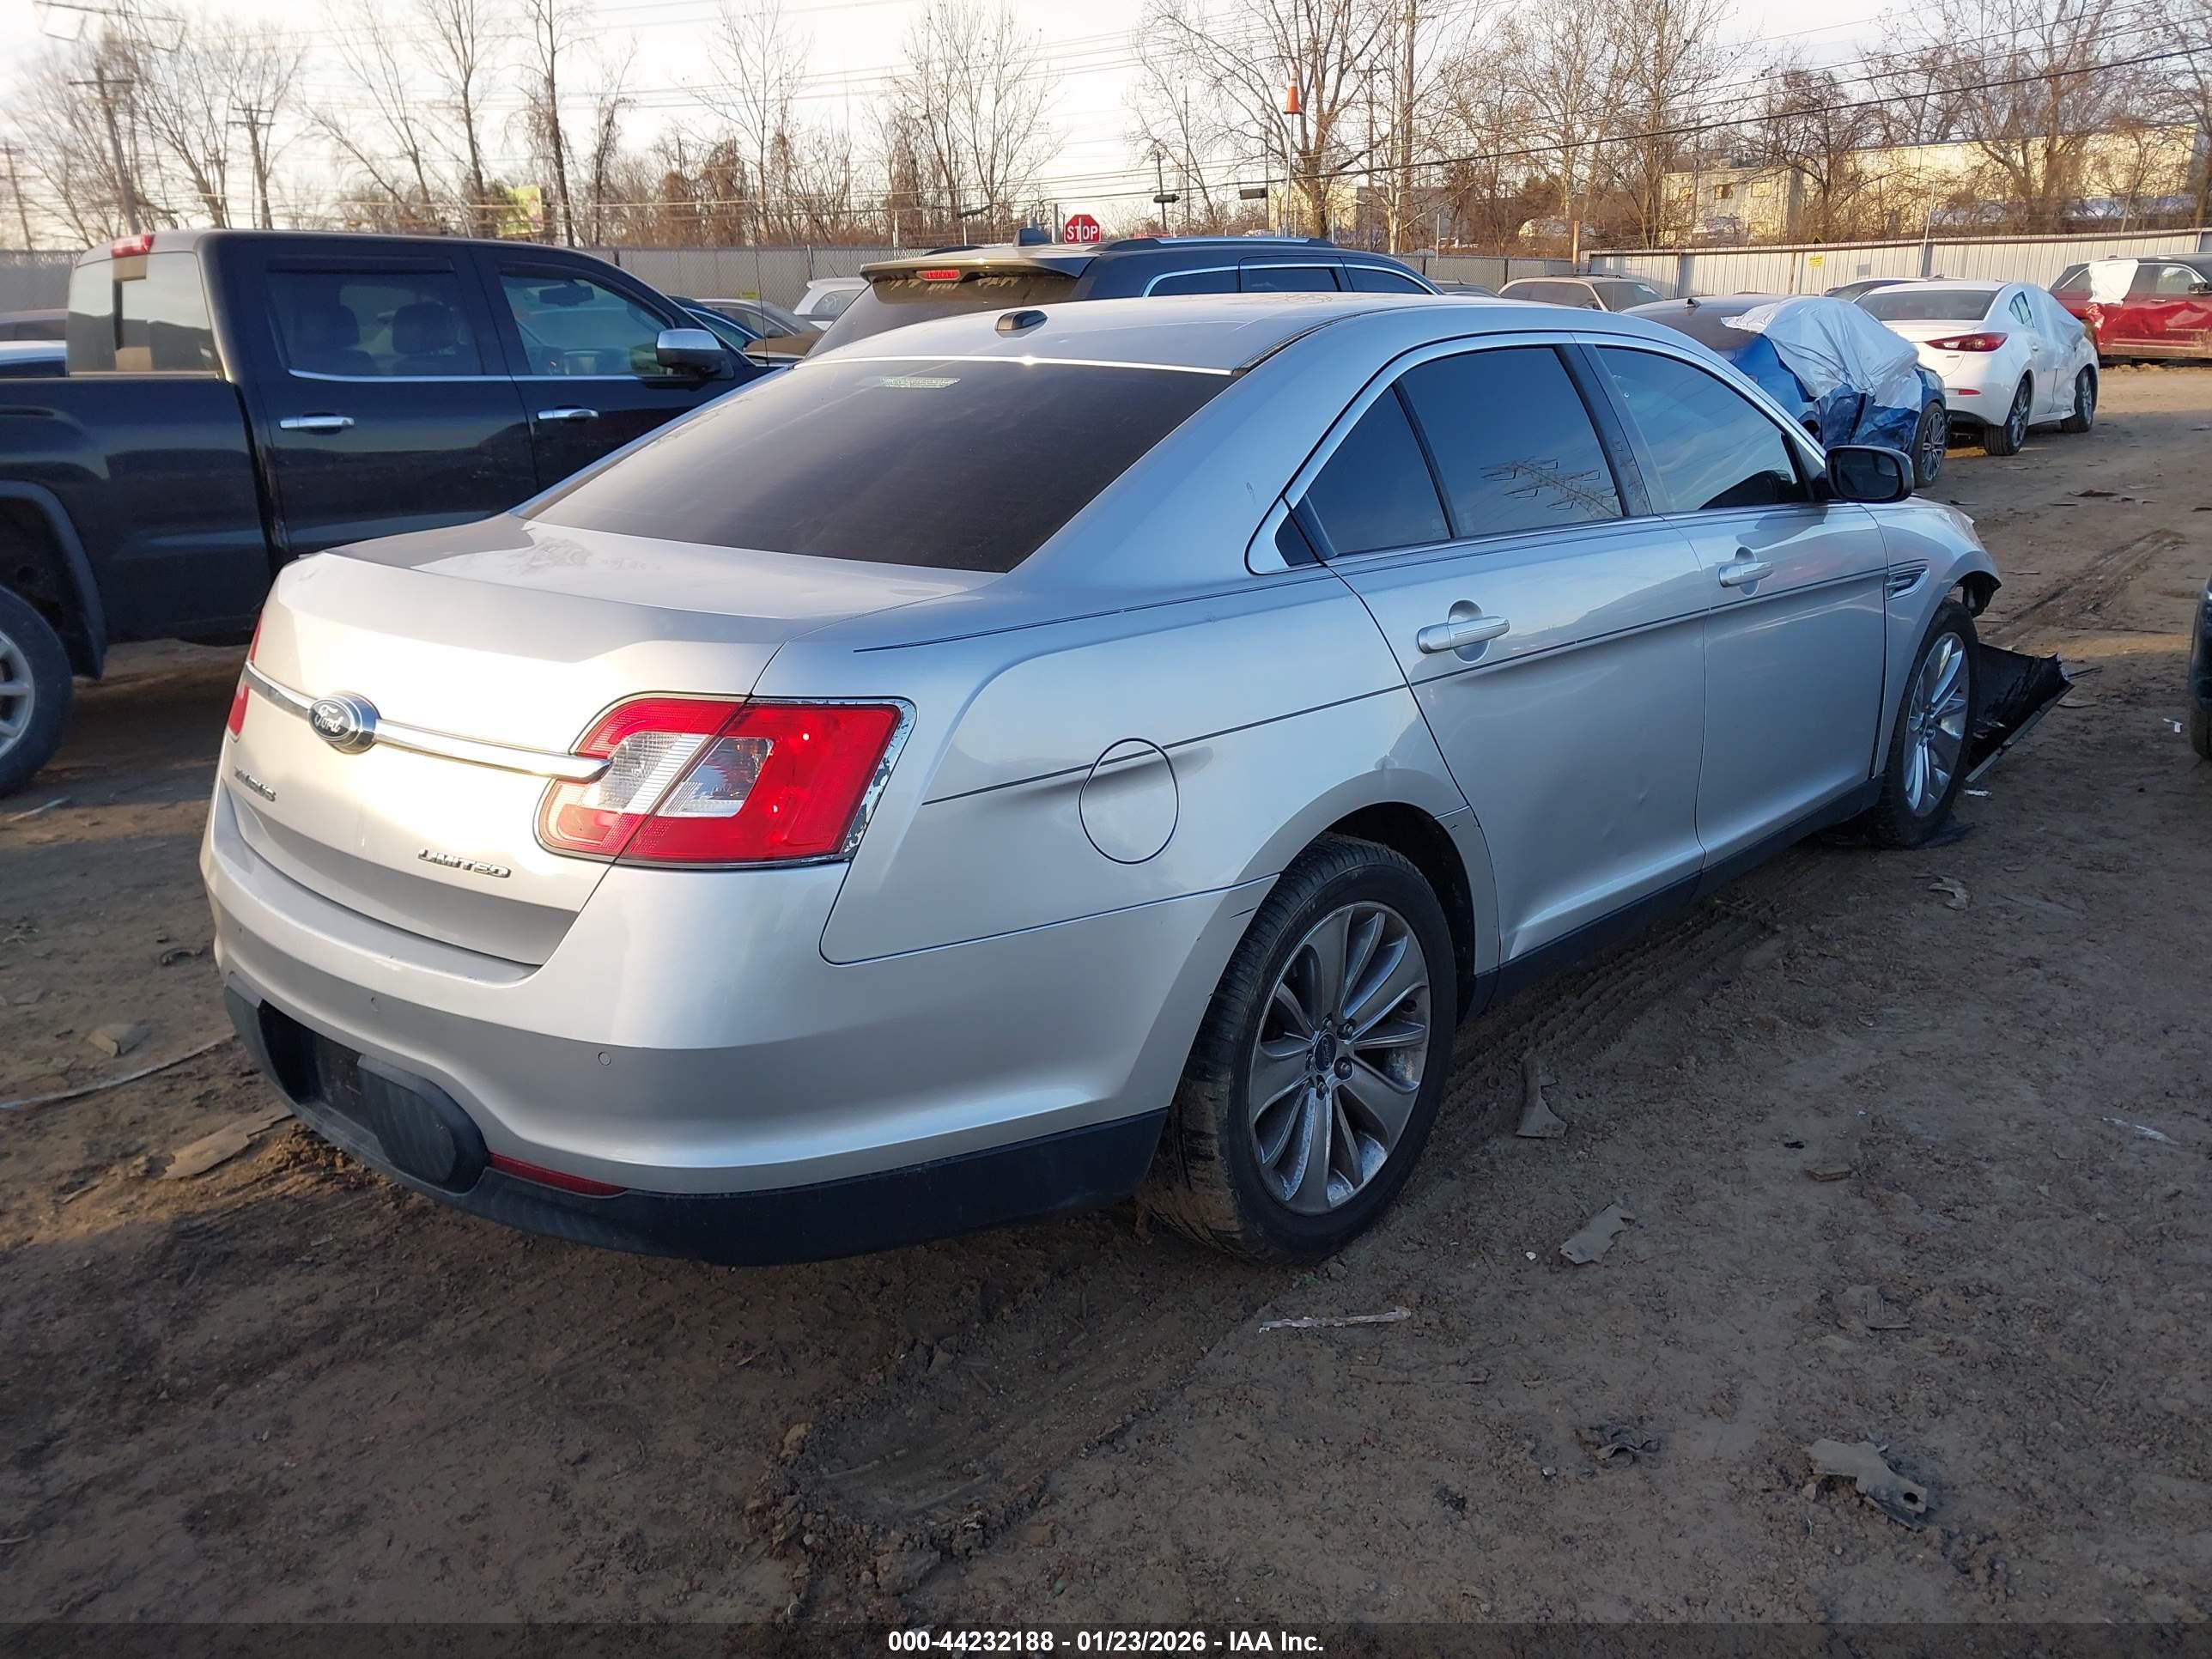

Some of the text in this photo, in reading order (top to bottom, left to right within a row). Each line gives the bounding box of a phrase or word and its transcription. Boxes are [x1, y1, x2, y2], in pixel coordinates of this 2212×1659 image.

[1066, 225, 1098, 240] STOP
[315, 704, 344, 733] Ford
[417, 849, 512, 878] LIMITED
